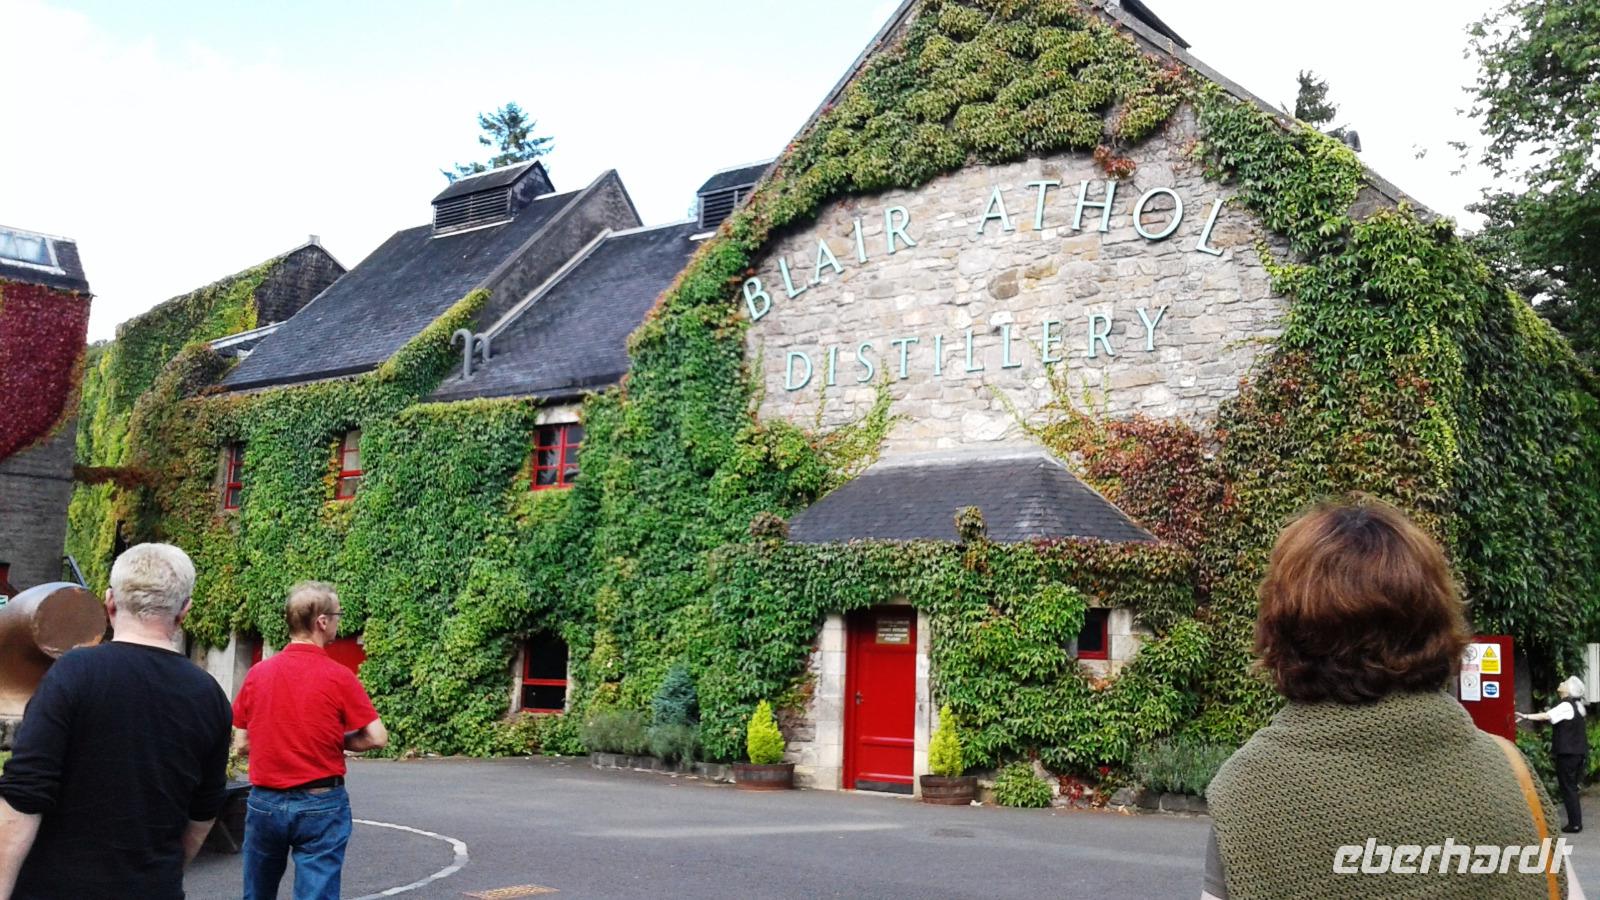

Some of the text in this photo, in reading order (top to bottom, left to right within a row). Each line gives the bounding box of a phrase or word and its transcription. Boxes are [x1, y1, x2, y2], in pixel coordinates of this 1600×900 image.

[743, 180, 1227, 321] BLAIR ATHOL
[785, 304, 1169, 391] DISTILLERY
